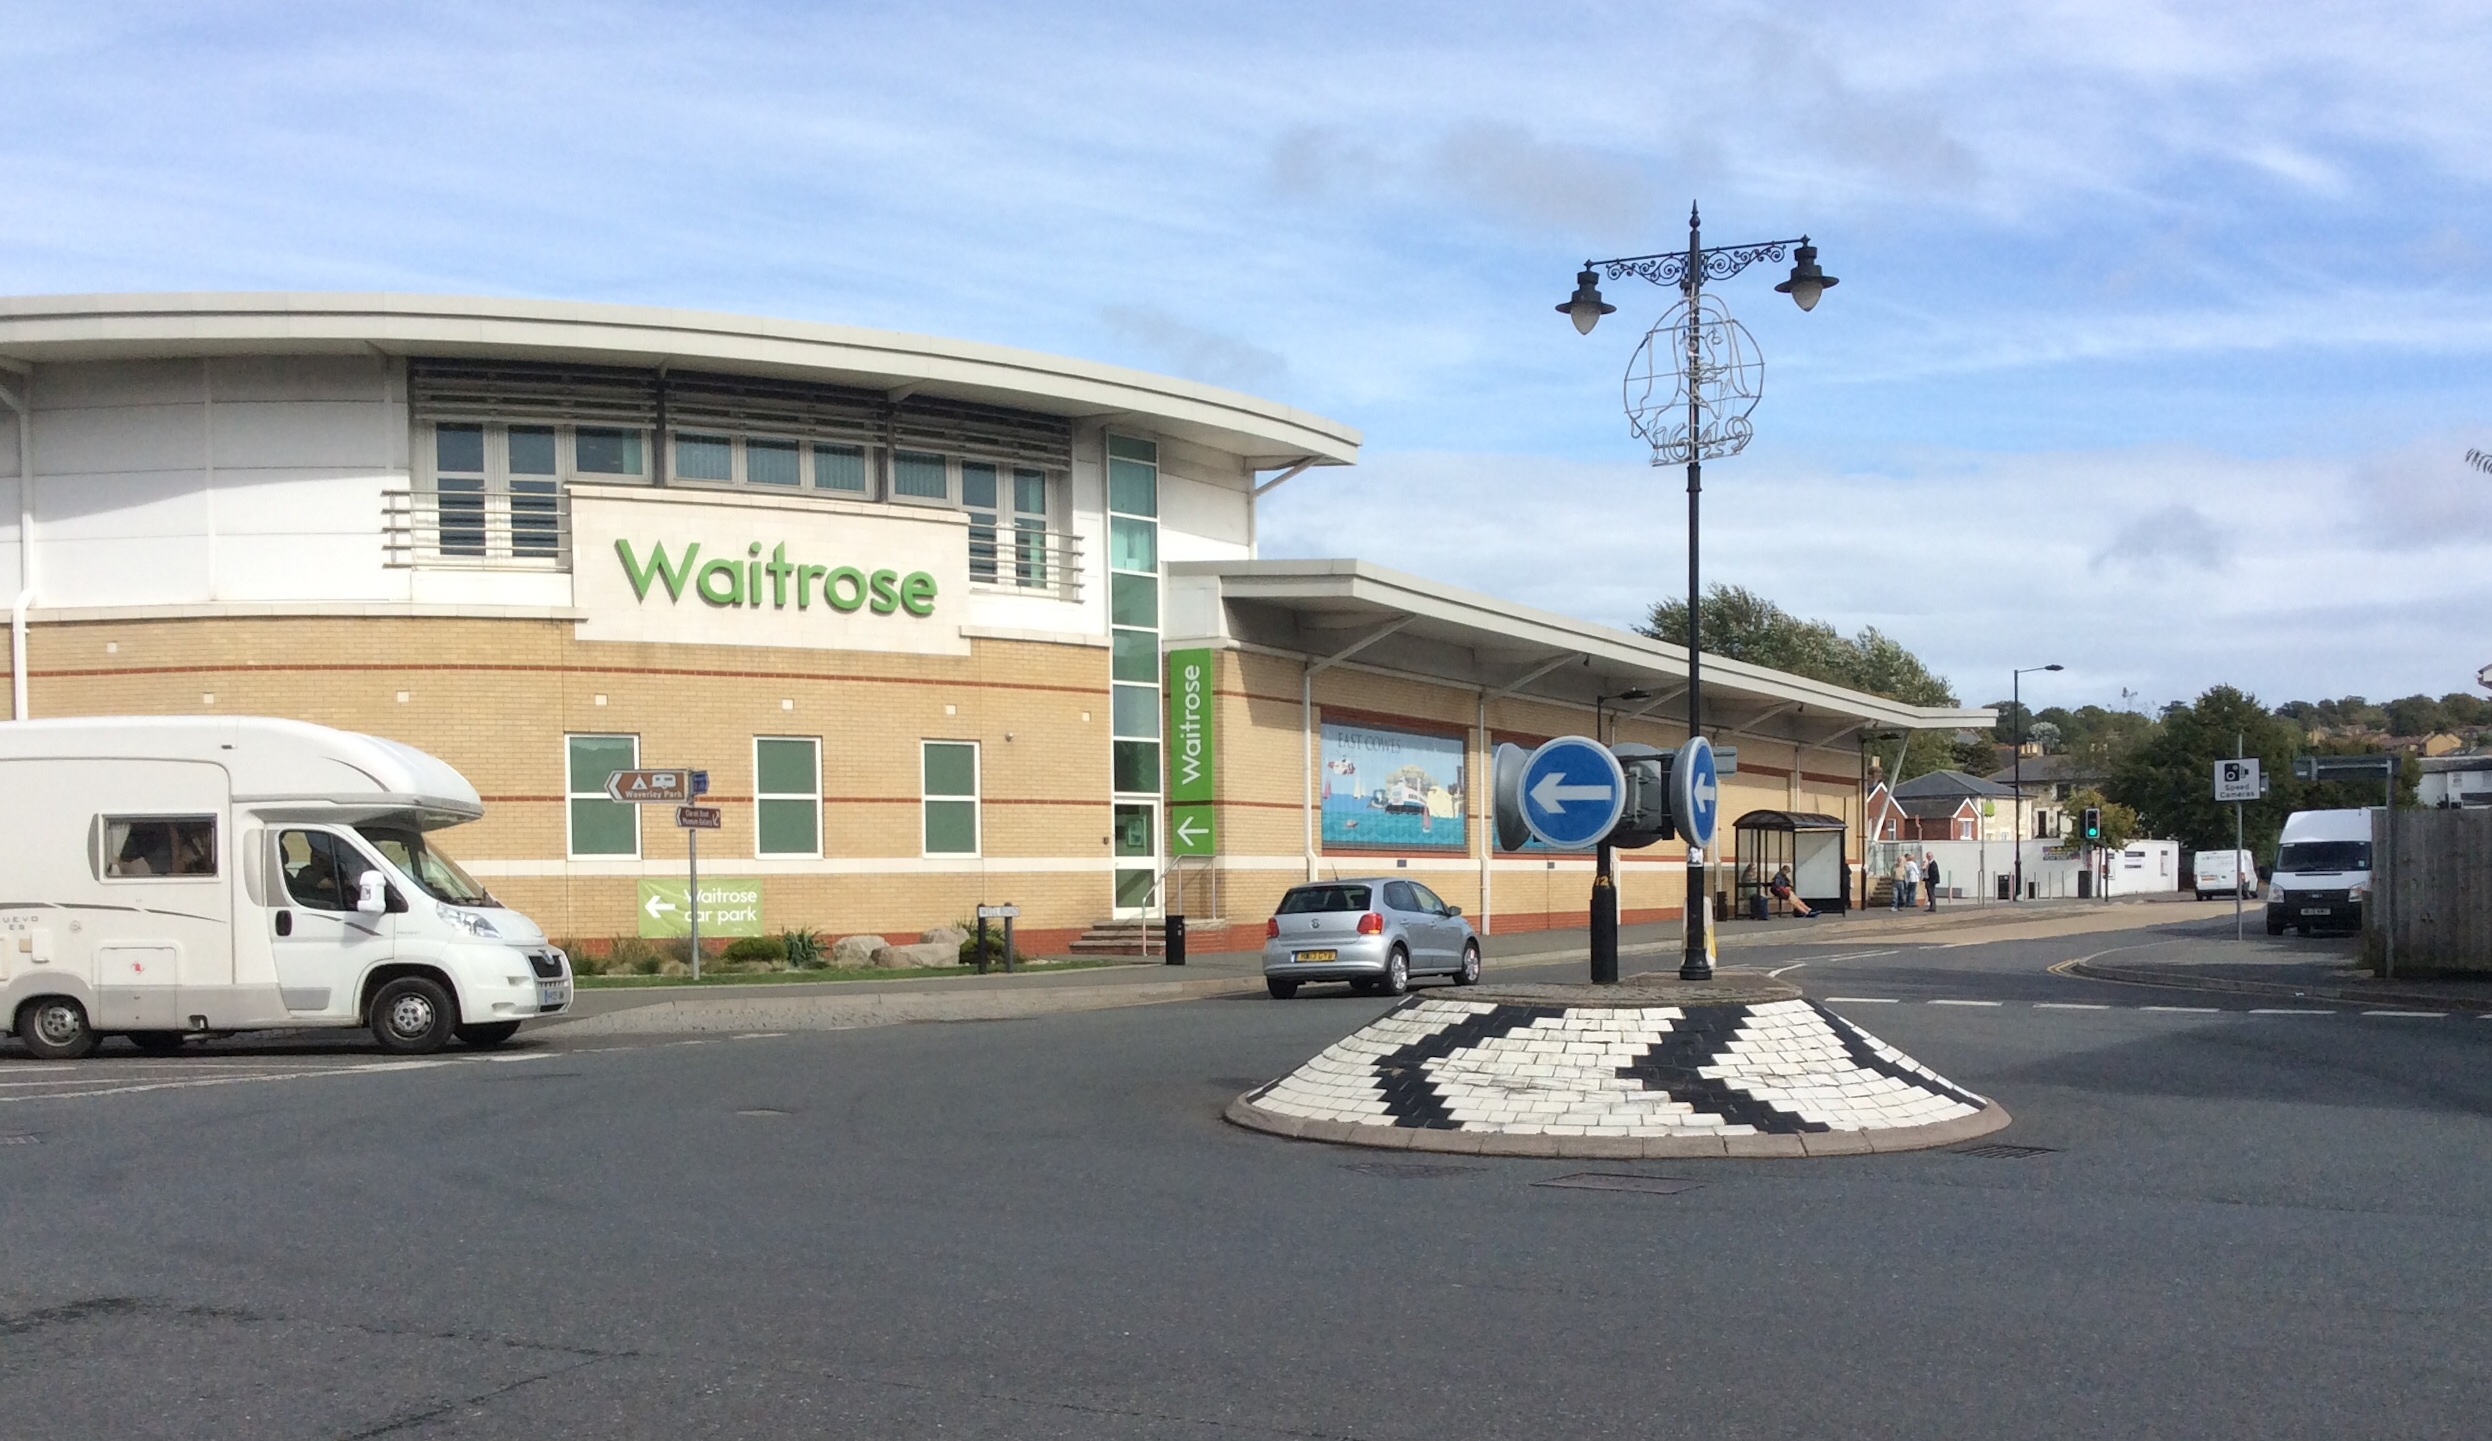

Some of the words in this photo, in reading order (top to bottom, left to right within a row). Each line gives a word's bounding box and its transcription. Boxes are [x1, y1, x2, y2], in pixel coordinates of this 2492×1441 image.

[1649, 416, 1753, 466] 1649
[614, 538, 939, 617] Waitrose
[1179, 664, 1202, 786] Waitrose
[1338, 732, 1362, 751] EAST
[1364, 735, 1402, 755] COWES
[624, 790, 661, 799] Waverley
[663, 790, 683, 798] Park
[2220, 791, 2255, 799] Cameras
[2224, 783, 2250, 792] Speed
[683, 887, 758, 904] Waitrose
[684, 910, 713, 922] car
[718, 905, 757, 926] park
